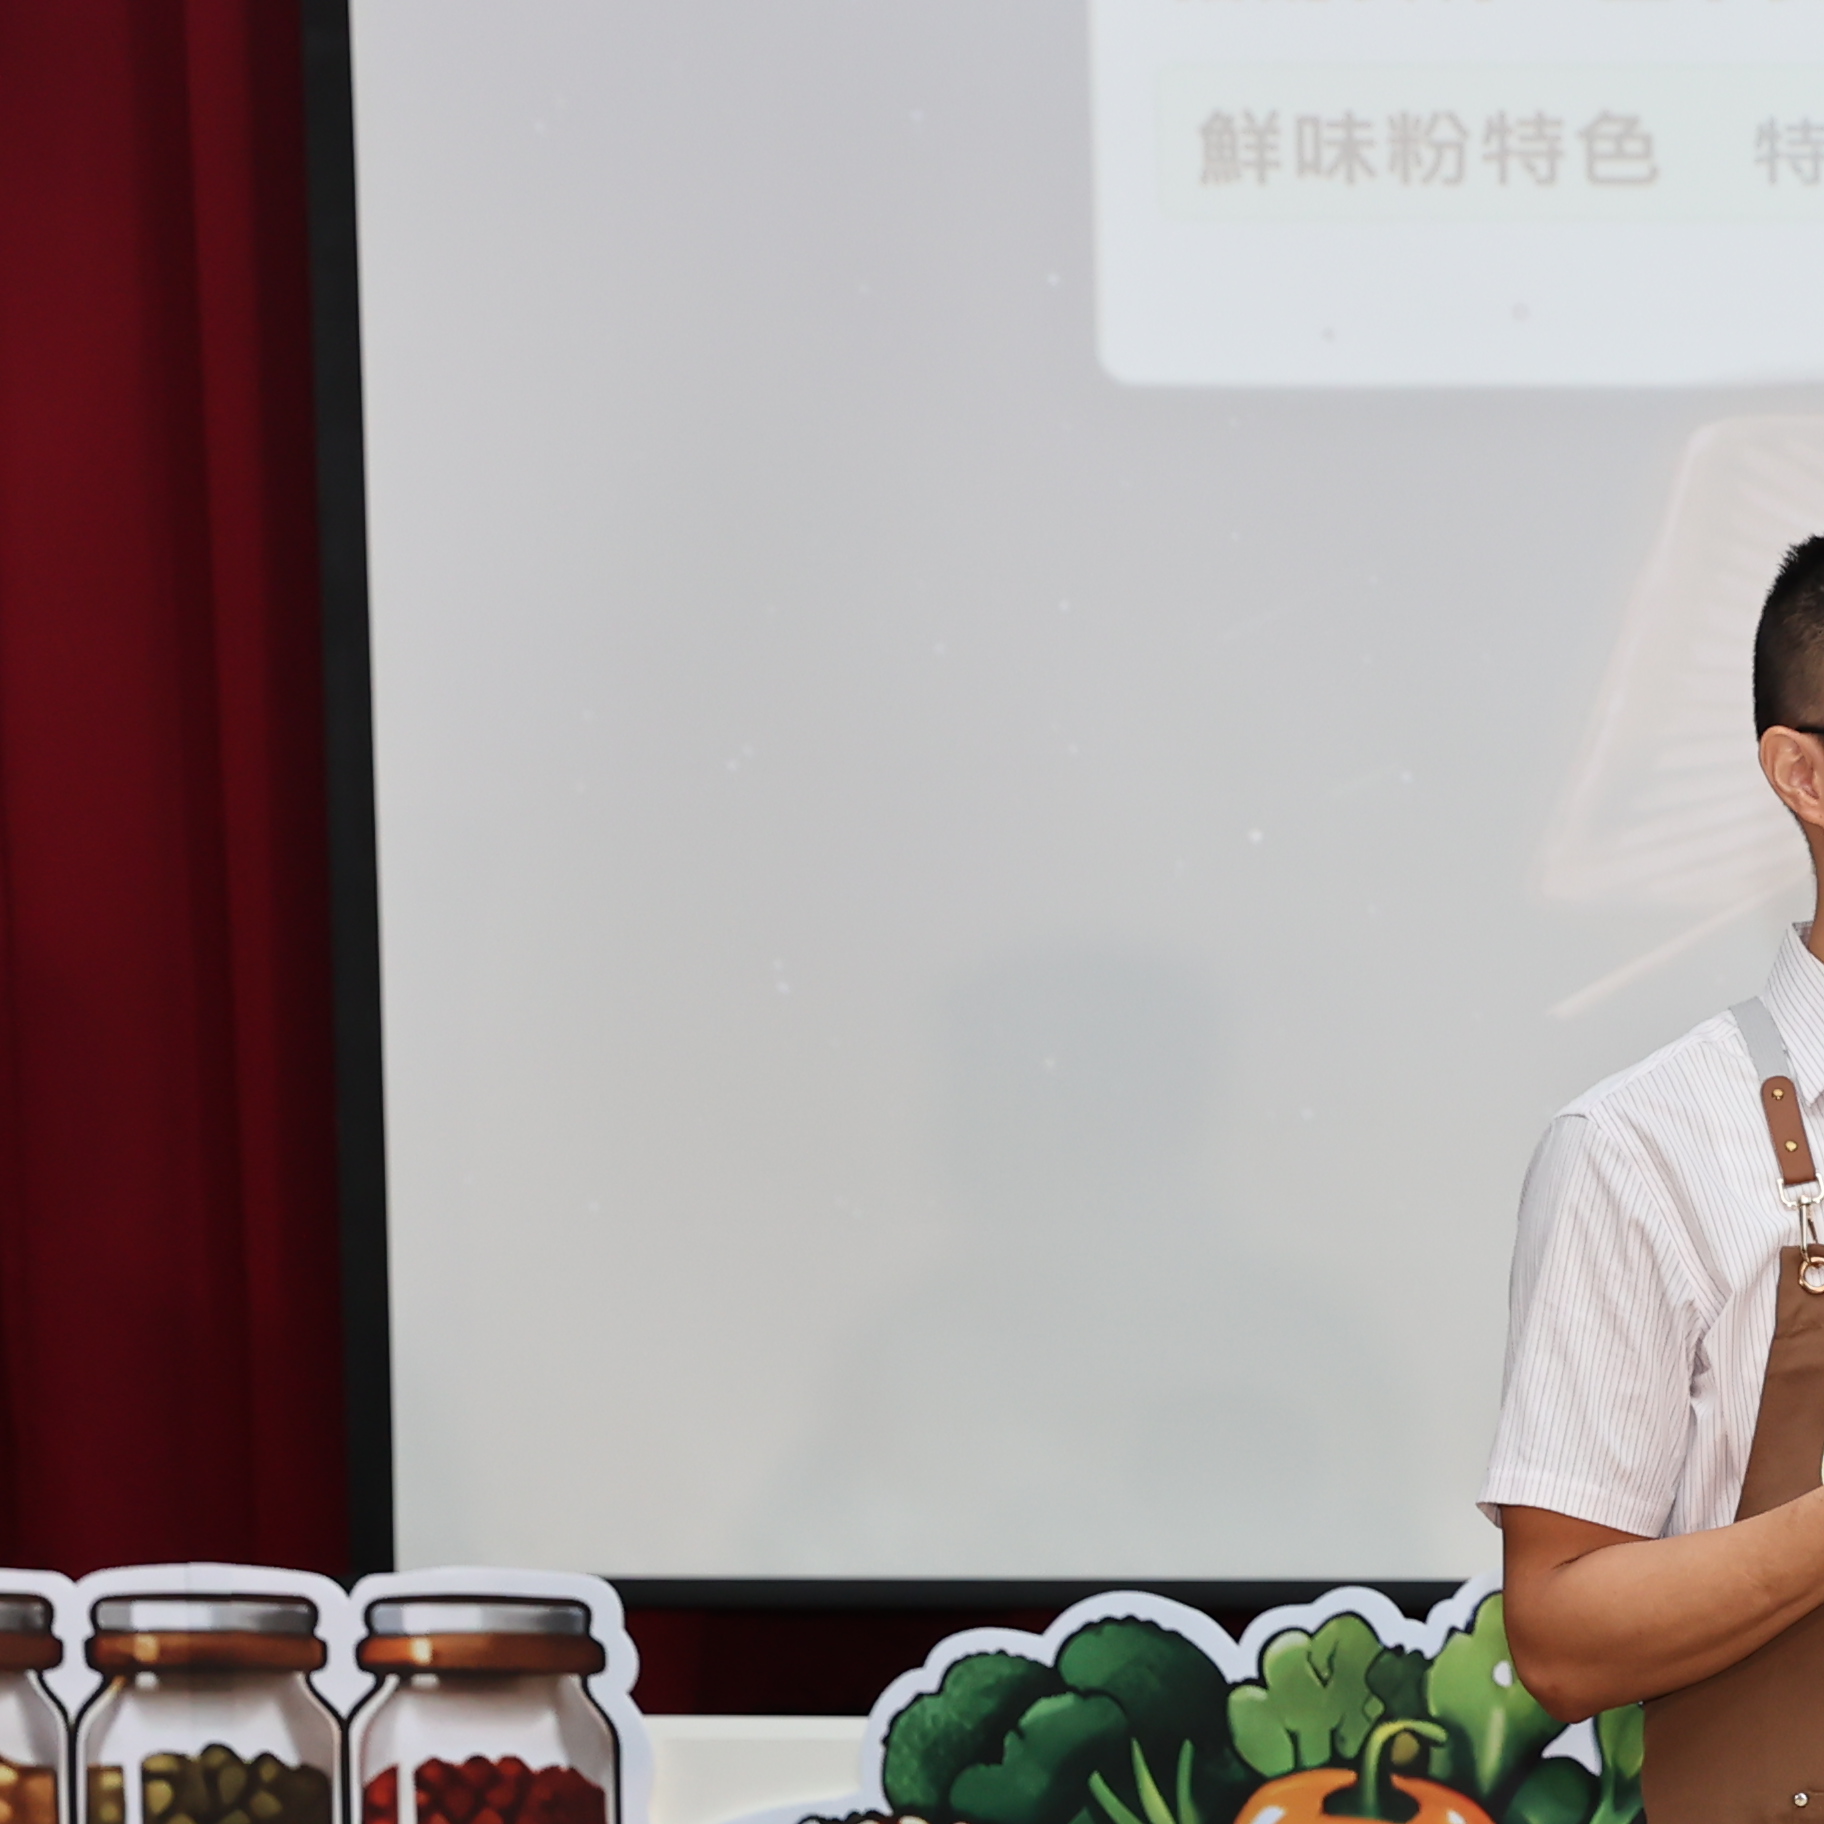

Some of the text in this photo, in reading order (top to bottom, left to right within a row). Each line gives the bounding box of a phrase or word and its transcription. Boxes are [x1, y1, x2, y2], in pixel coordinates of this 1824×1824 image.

[1198, 108, 1661, 188] 鮮味粉特色
